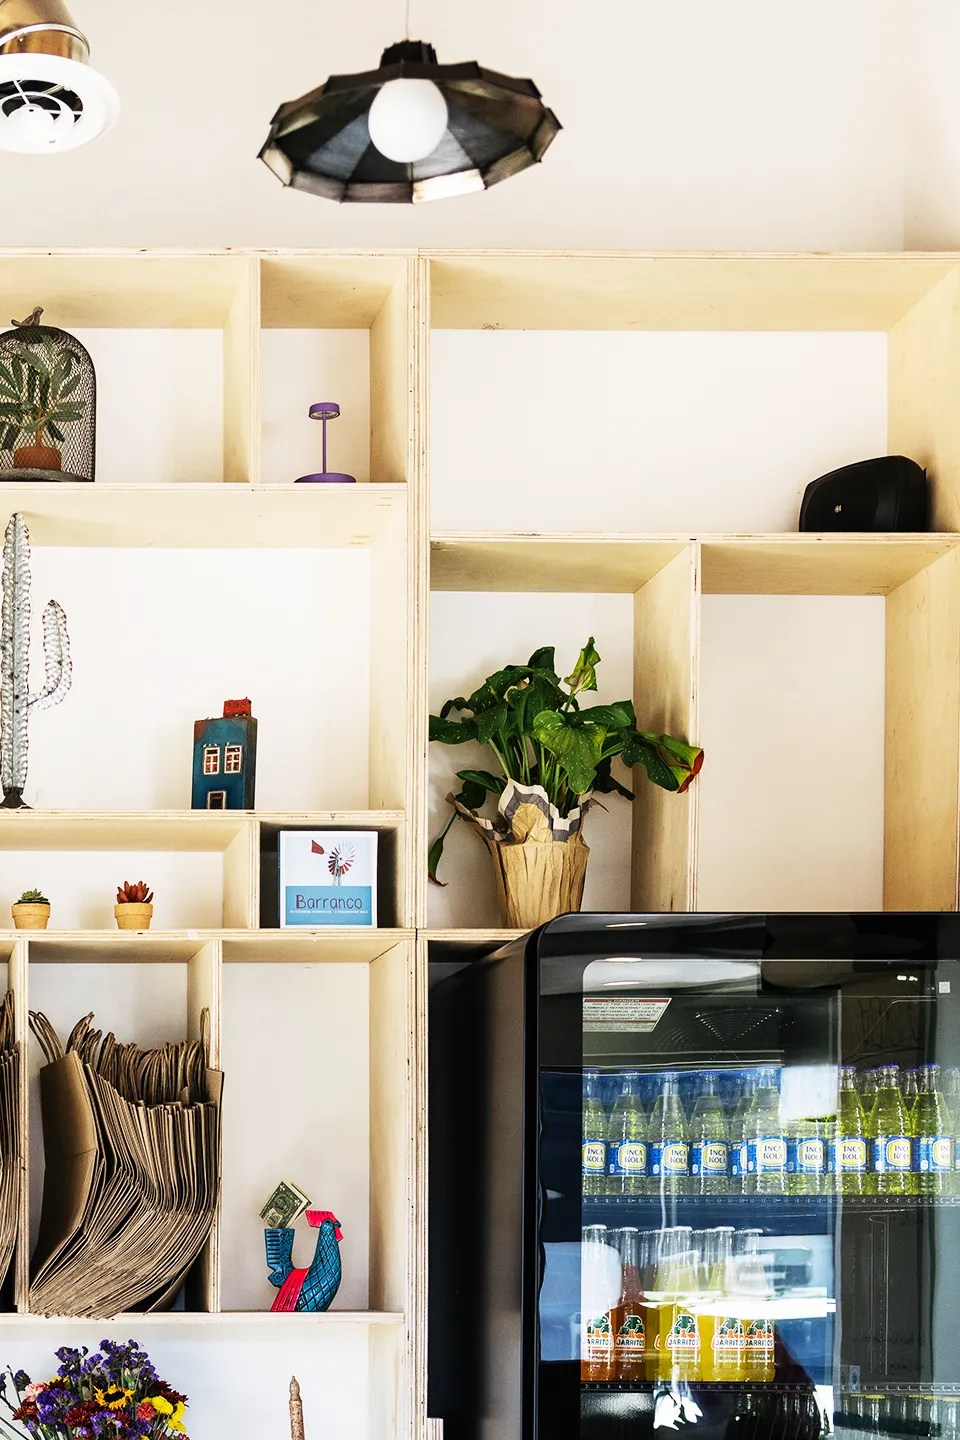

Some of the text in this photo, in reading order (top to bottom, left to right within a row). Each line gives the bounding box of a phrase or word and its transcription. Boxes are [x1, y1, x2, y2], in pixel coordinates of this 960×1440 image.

[296, 894, 363, 909] Barranco
[708, 1156, 727, 1164] KOLA
[616, 1338, 645, 1346] JARRITOS
[668, 1338, 699, 1346] JARRITOS
